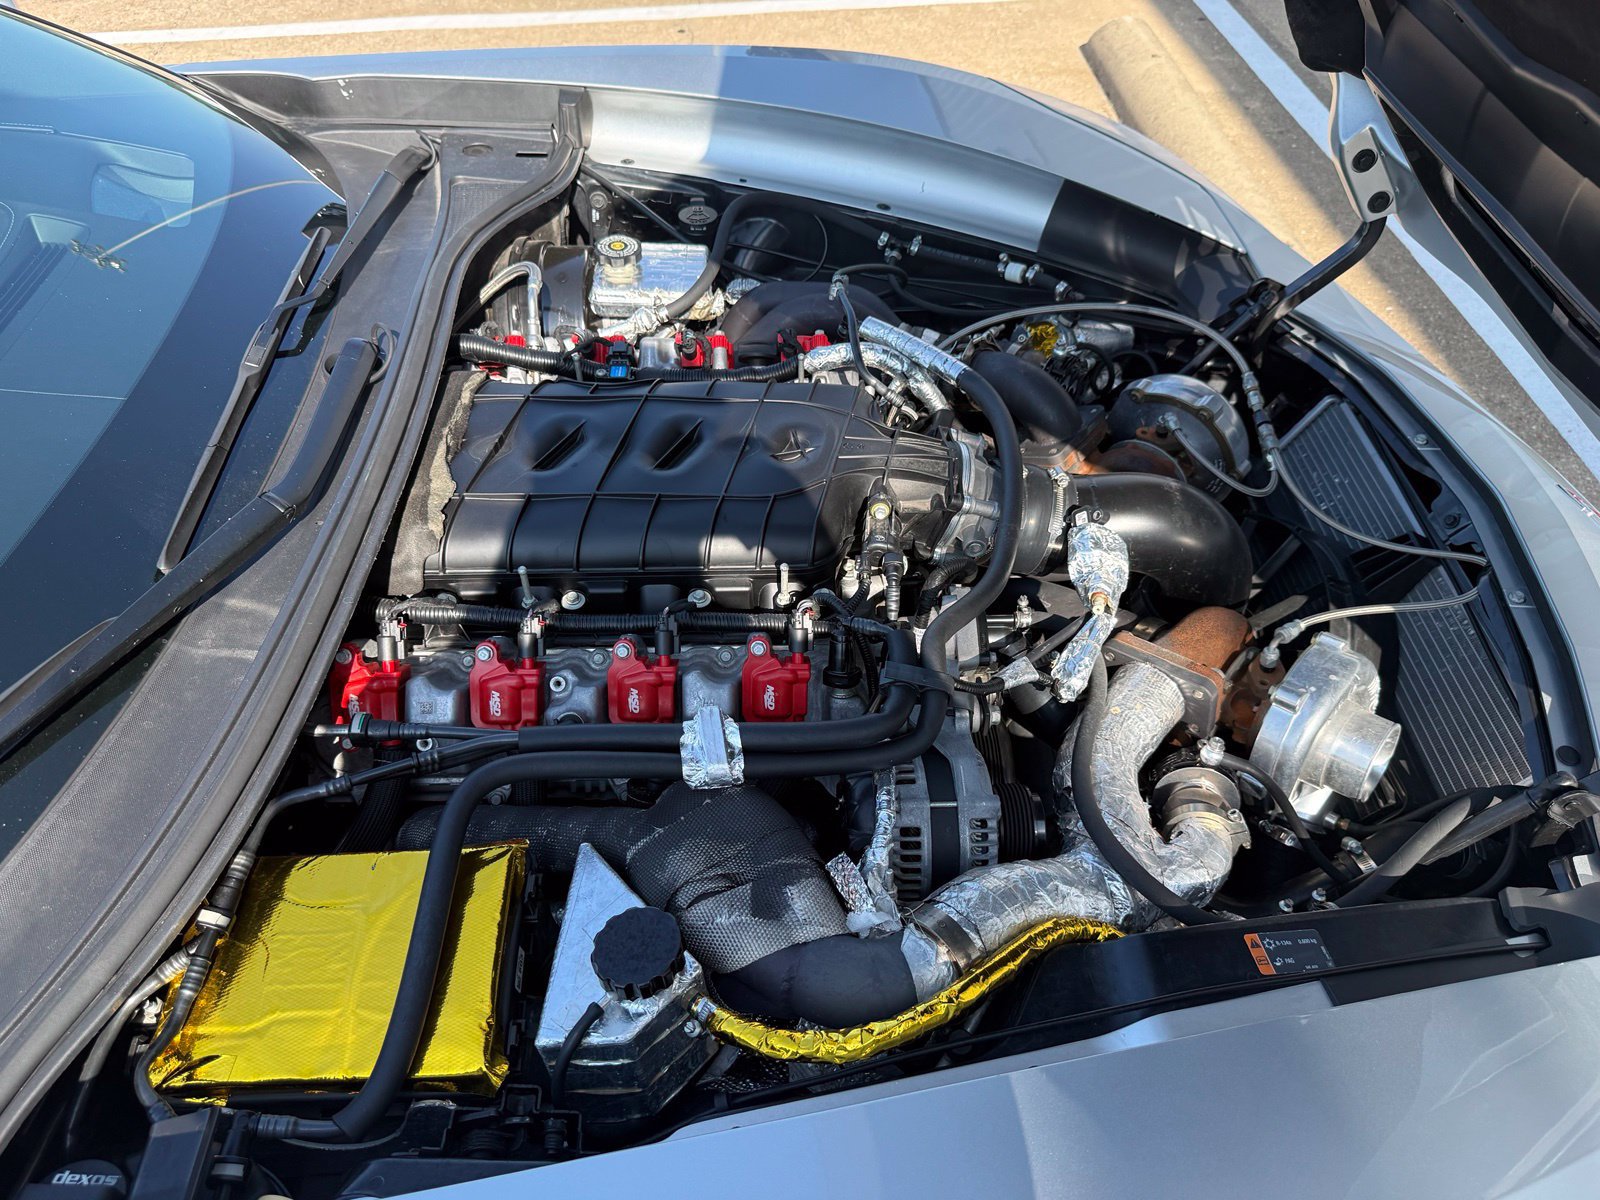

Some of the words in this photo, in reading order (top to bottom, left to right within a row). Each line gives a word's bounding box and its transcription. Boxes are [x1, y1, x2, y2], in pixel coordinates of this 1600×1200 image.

[489, 690, 501, 717] MSD
[628, 687, 640, 714] MSD
[764, 684, 775, 711] MSD
[51, 1170, 120, 1186] dexos
